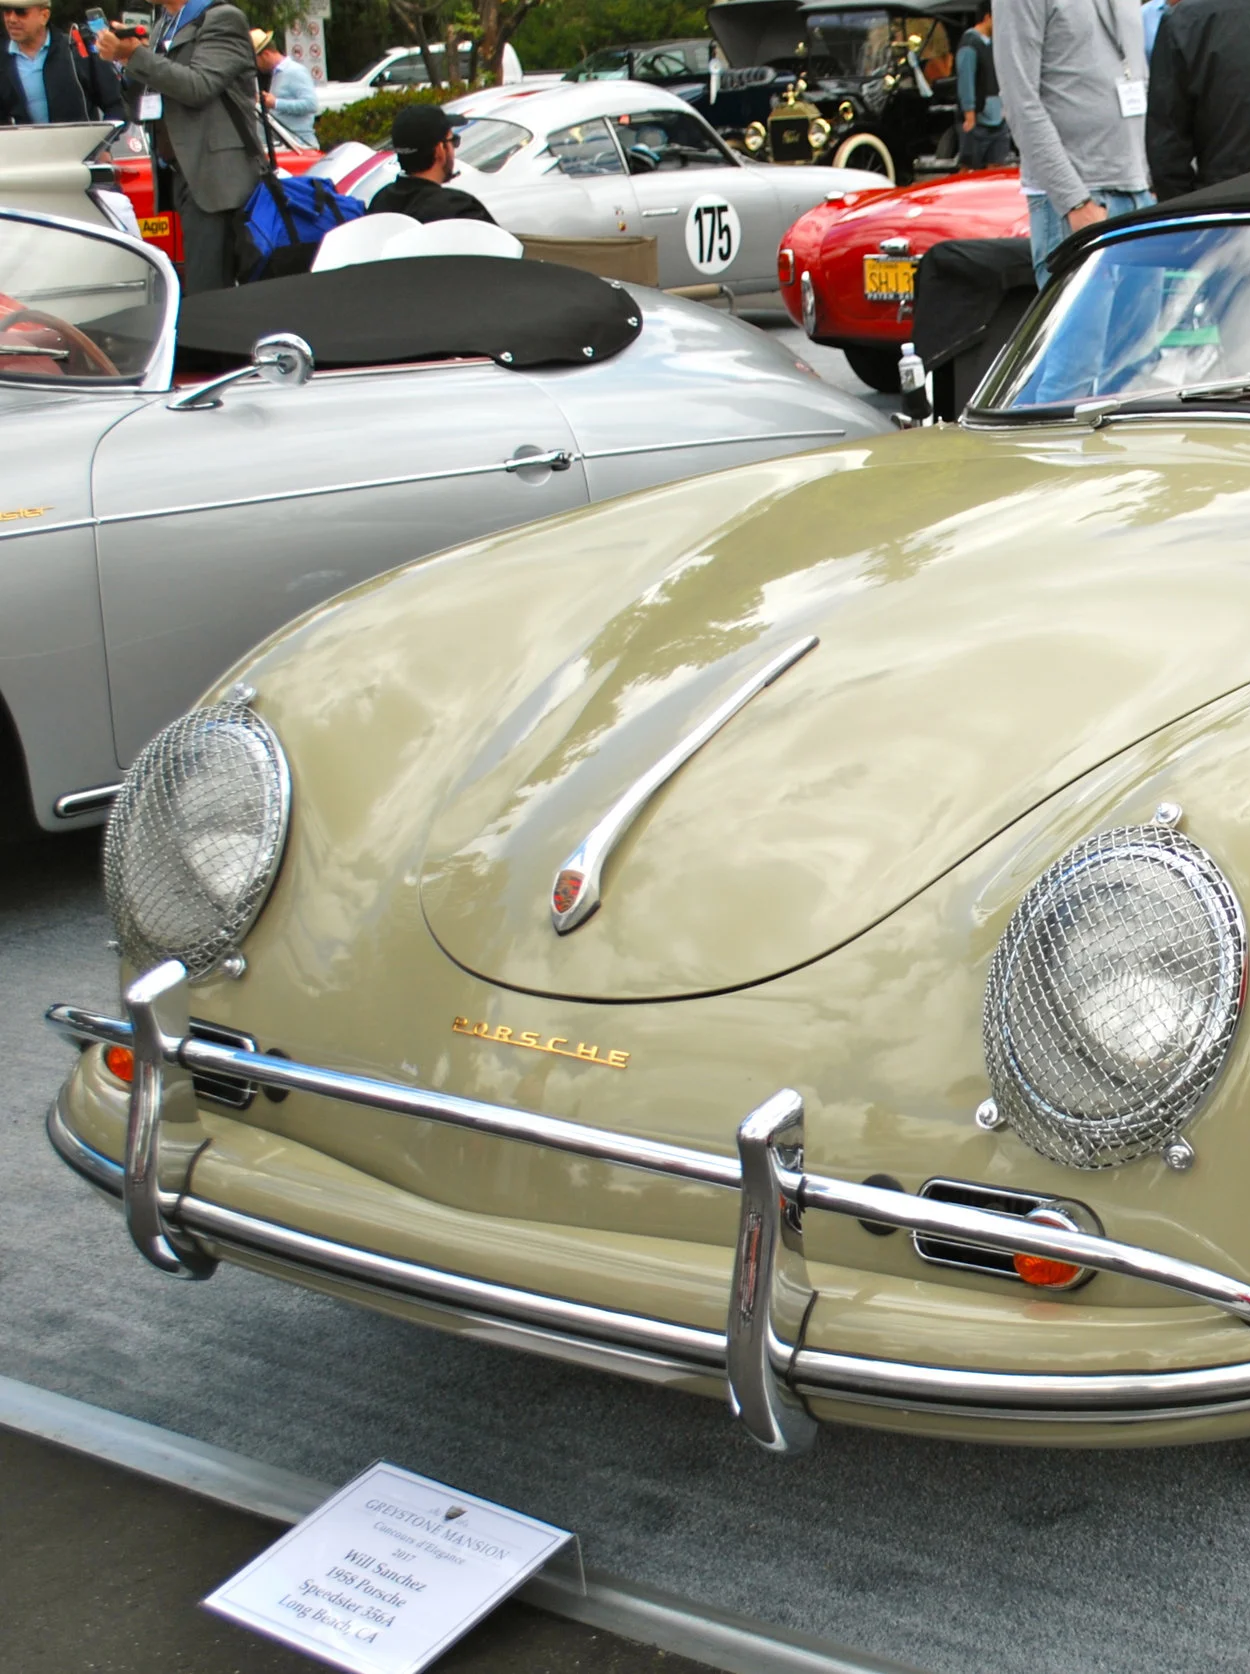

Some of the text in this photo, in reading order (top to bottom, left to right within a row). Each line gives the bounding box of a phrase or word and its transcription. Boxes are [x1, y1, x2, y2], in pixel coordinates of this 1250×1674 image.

[142, 219, 168, 234] Agip
[694, 205, 731, 264] 175
[453, 1016, 631, 1069] PORSCHE
[365, 1498, 511, 1561] GREYSTONE MANSION
[373, 1521, 417, 1545] Concours
[344, 1548, 428, 1593] Will Sanchez
[391, 1548, 417, 1562] 2017
[298, 1578, 397, 1628] Speedster 356A
[325, 1566, 407, 1609] 1958 Porsche
[278, 1594, 380, 1644] Long Beach, CA
